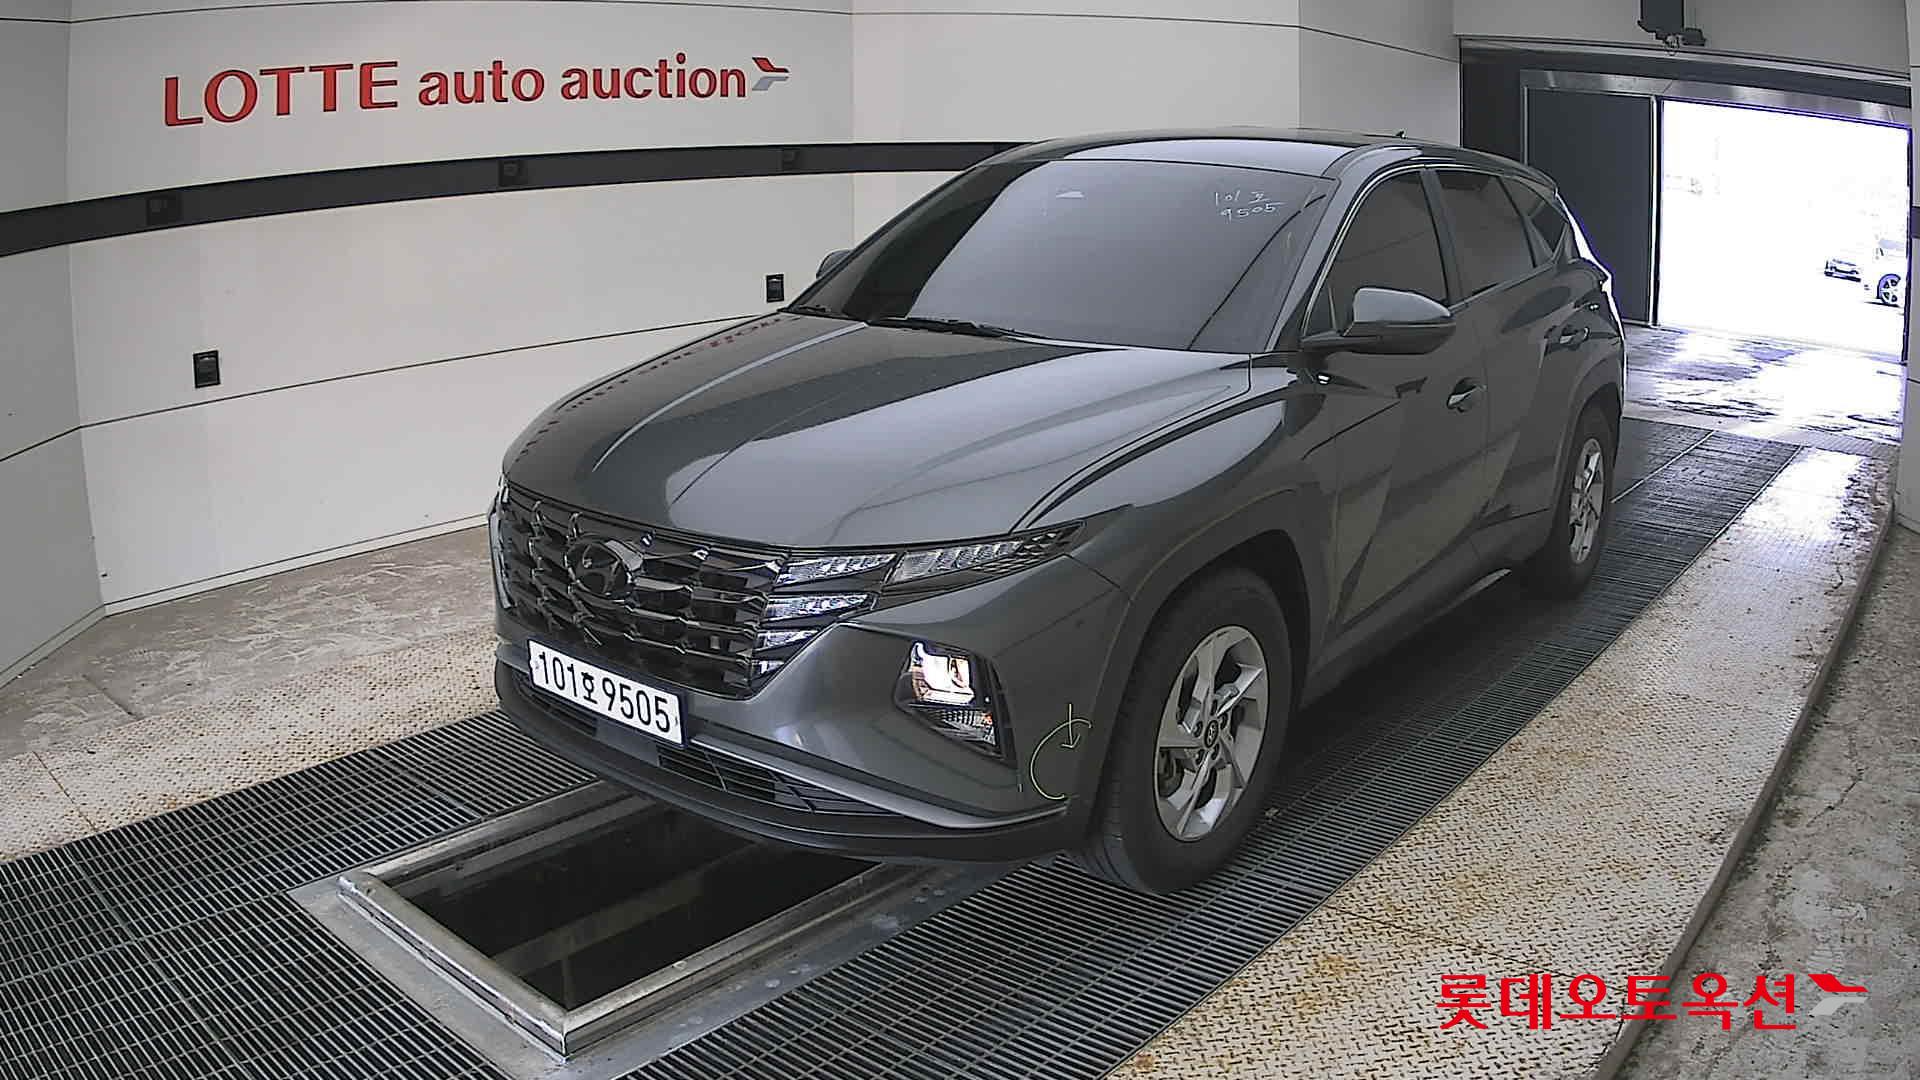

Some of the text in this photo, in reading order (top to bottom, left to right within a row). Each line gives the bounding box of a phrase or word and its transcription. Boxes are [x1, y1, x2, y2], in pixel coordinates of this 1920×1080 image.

[163, 52, 747, 127] LOTTE auto auction
[1220, 202, 1287, 222] 9505
